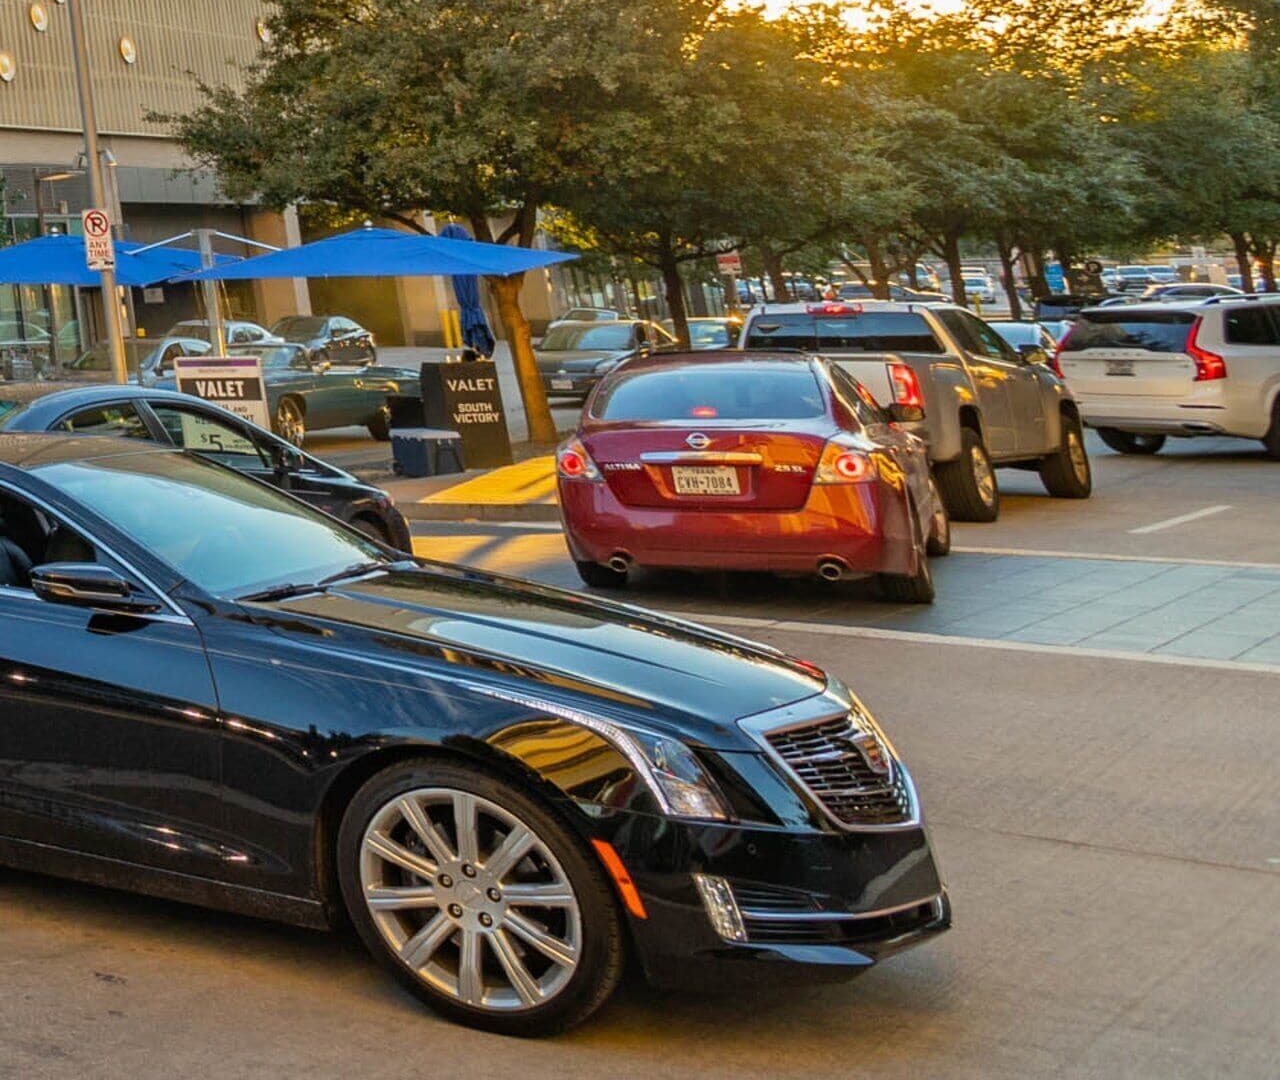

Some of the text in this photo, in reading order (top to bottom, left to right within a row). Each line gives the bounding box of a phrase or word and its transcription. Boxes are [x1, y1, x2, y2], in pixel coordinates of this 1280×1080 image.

[89, 241, 108, 249] ANY
[89, 249, 110, 258] TIME
[195, 380, 244, 398] VALET
[446, 378, 494, 391] VALET
[457, 402, 493, 413] SOUTH
[452, 412, 500, 424] VICTORY
[604, 462, 641, 471] ALTIMA
